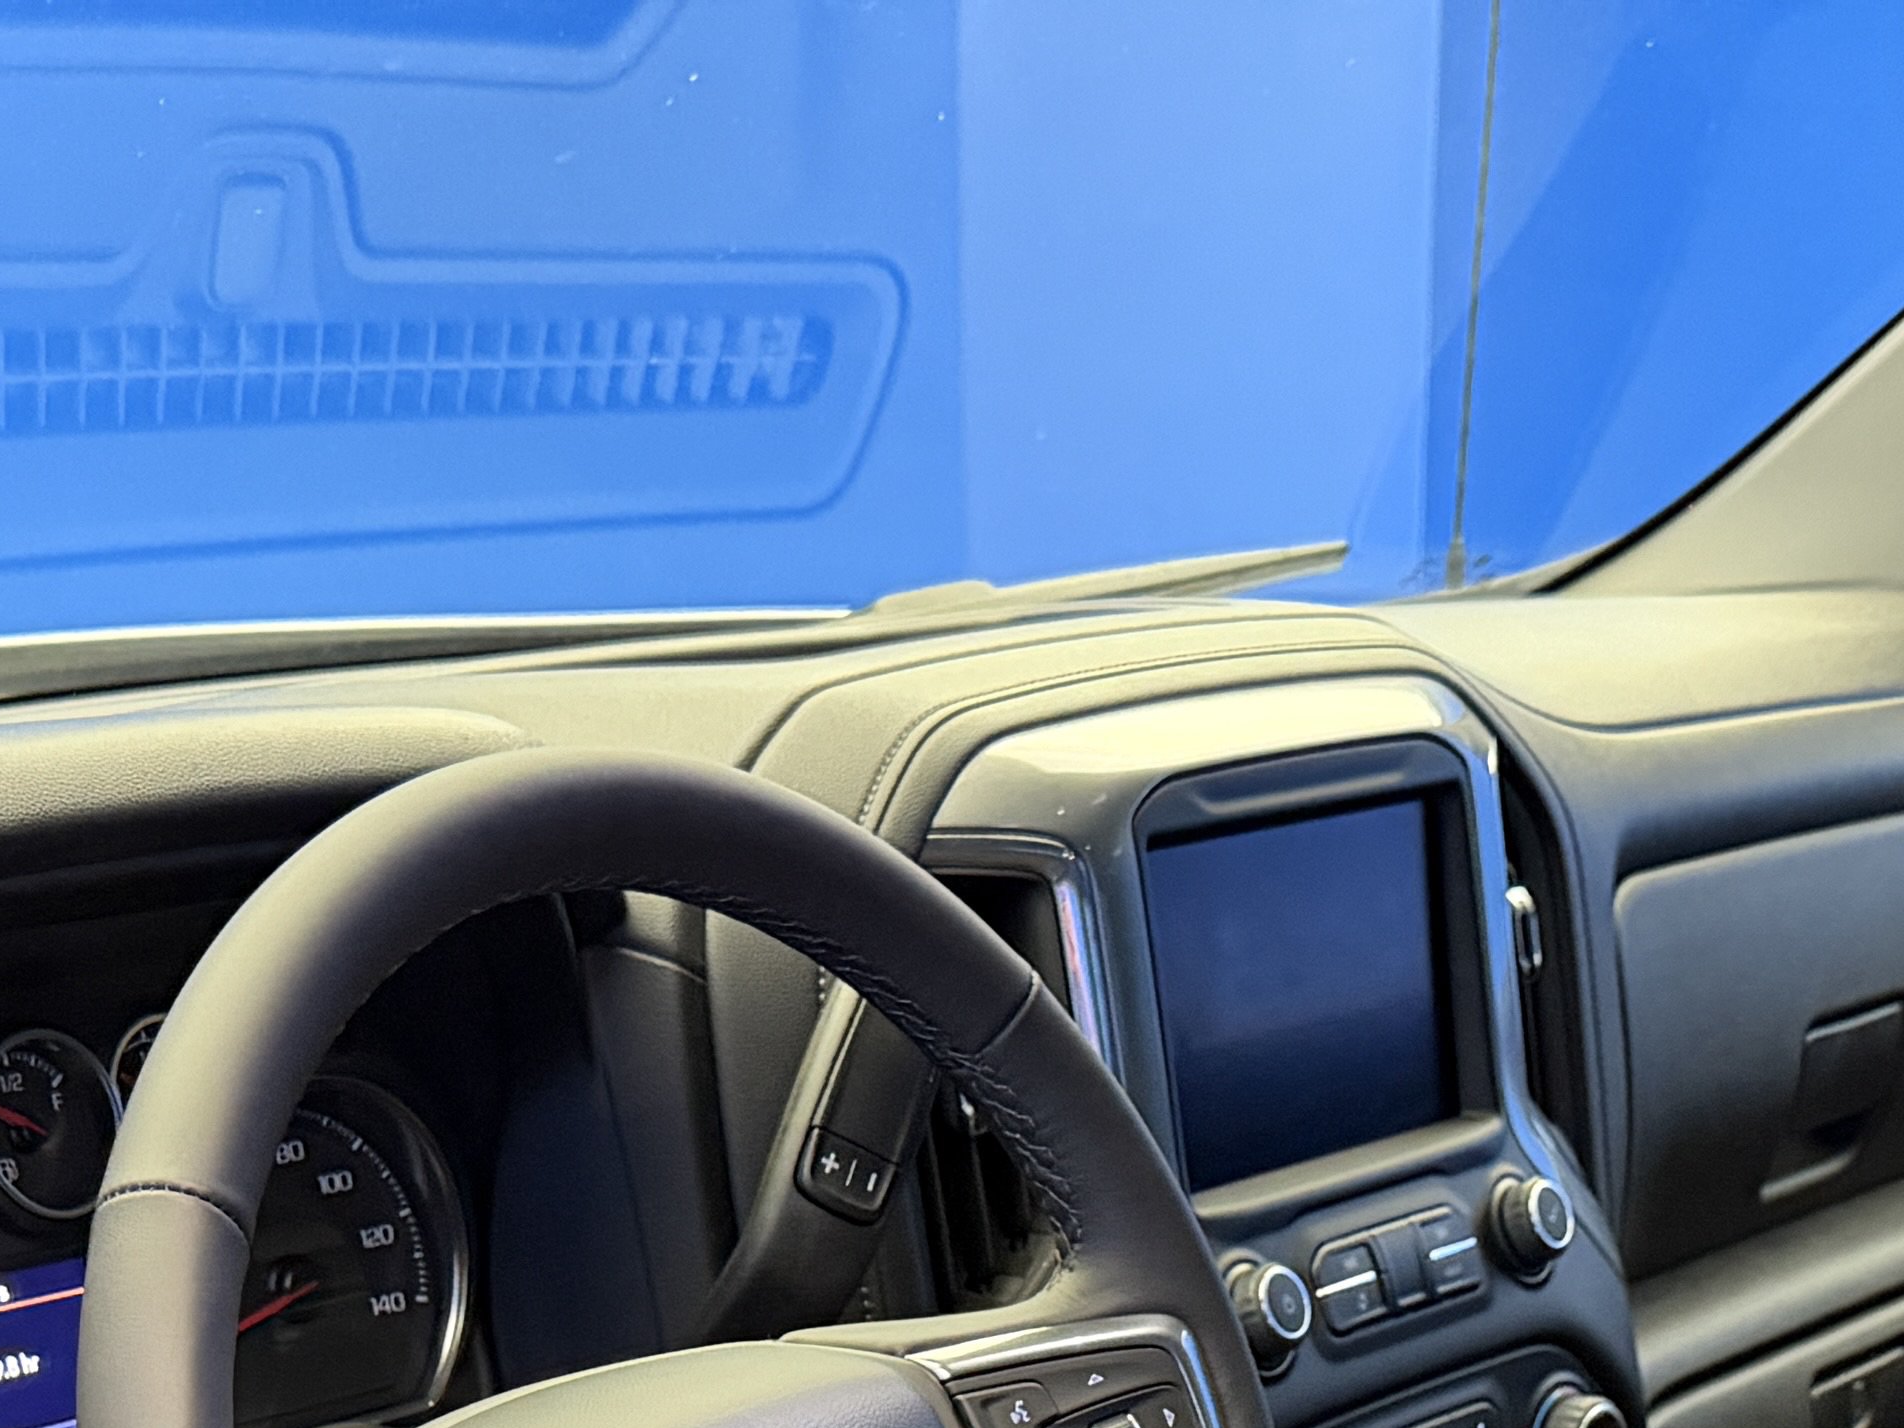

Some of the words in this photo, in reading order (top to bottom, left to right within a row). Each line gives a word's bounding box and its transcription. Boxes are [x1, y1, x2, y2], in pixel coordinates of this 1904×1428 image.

[51, 1092, 64, 1112] F
[276, 1140, 305, 1165] 80
[317, 1170, 353, 1195] 100
[360, 1223, 395, 1249] 120
[370, 1292, 406, 1317] 140
[19, 1352, 41, 1376] hr
